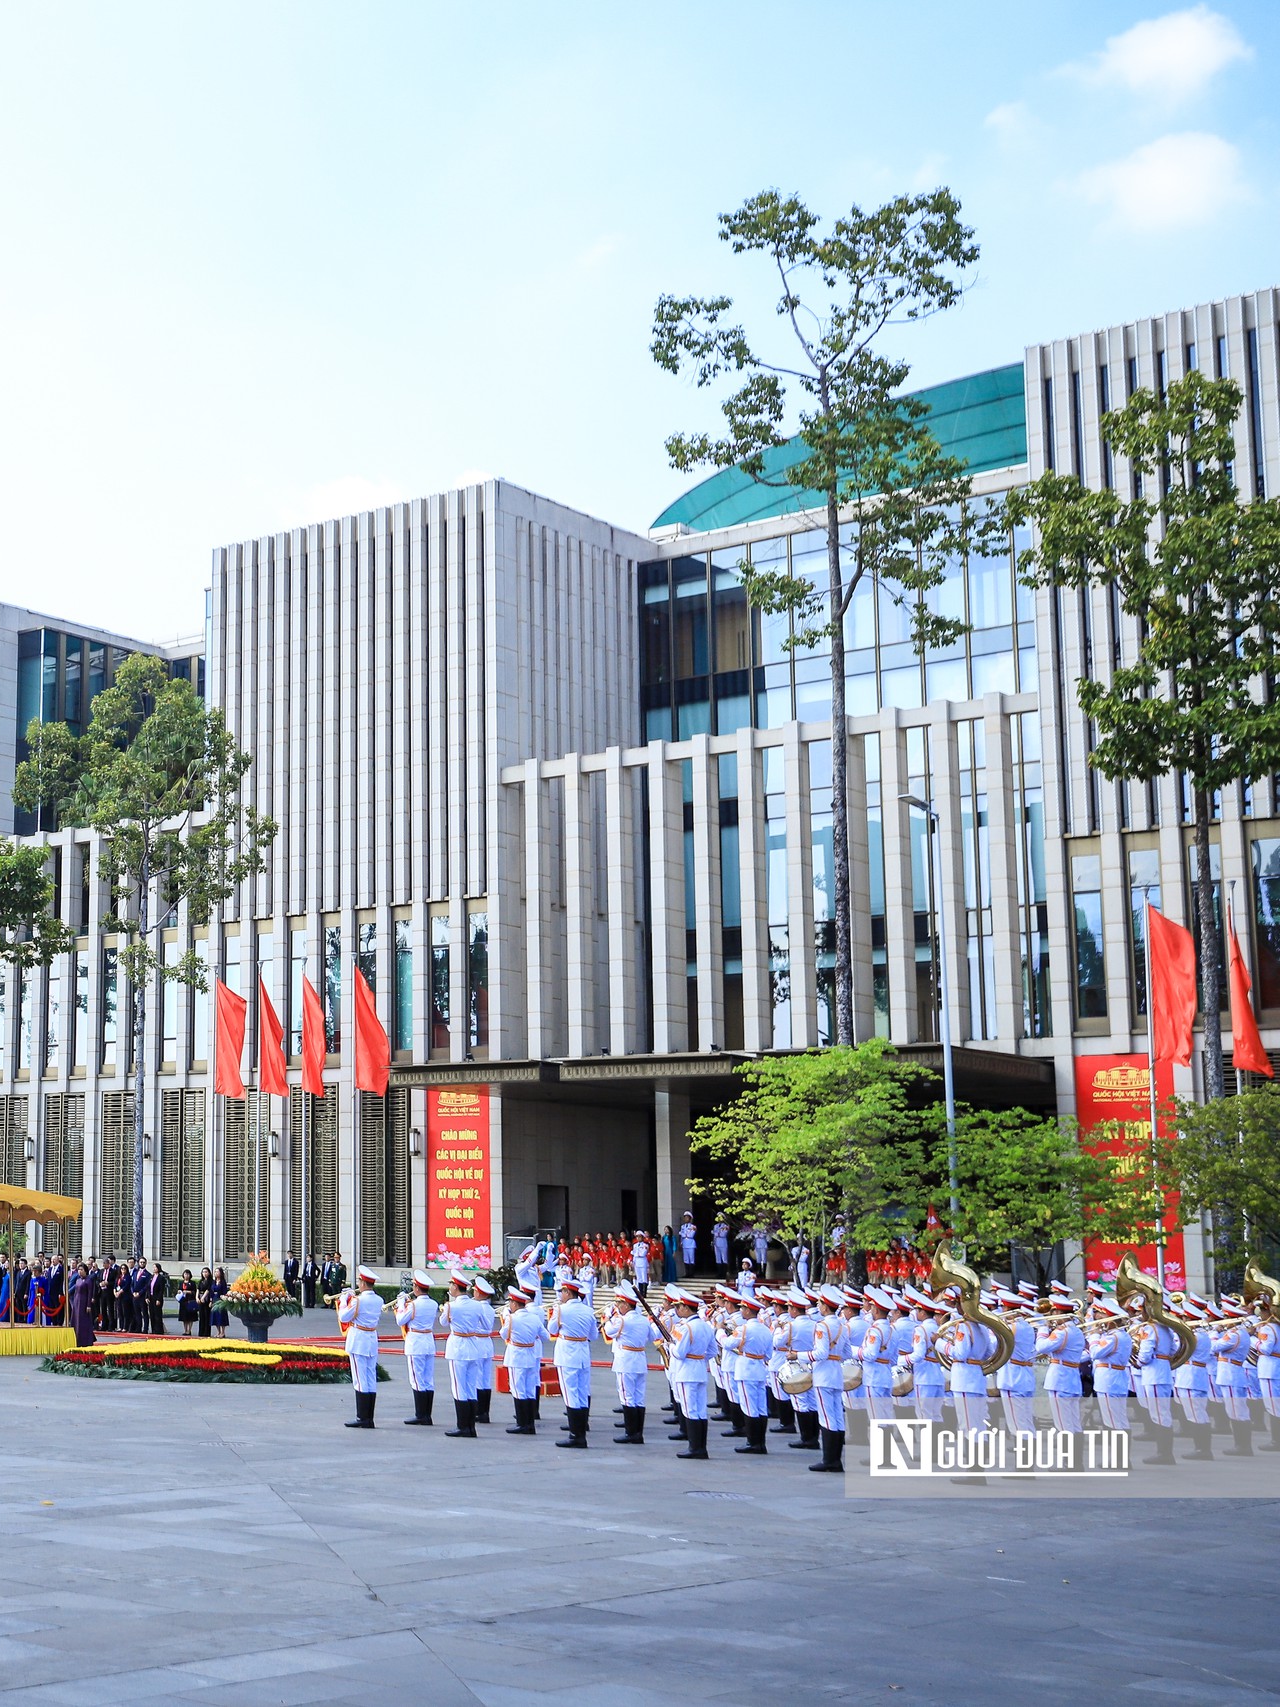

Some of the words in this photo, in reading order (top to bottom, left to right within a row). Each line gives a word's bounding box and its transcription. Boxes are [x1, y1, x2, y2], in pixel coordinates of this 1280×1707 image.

[1126, 1090, 1140, 1098] VIỆT
[436, 1148, 449, 1160] CÁC
[436, 1166, 453, 1180] QUỐC
[453, 1167, 465, 1181] HỘI
[474, 1168, 484, 1181] DỰ
[445, 1205, 462, 1219] QUỐC
[463, 1206, 474, 1220] HỘI
[445, 1226, 462, 1238] KHÓA
